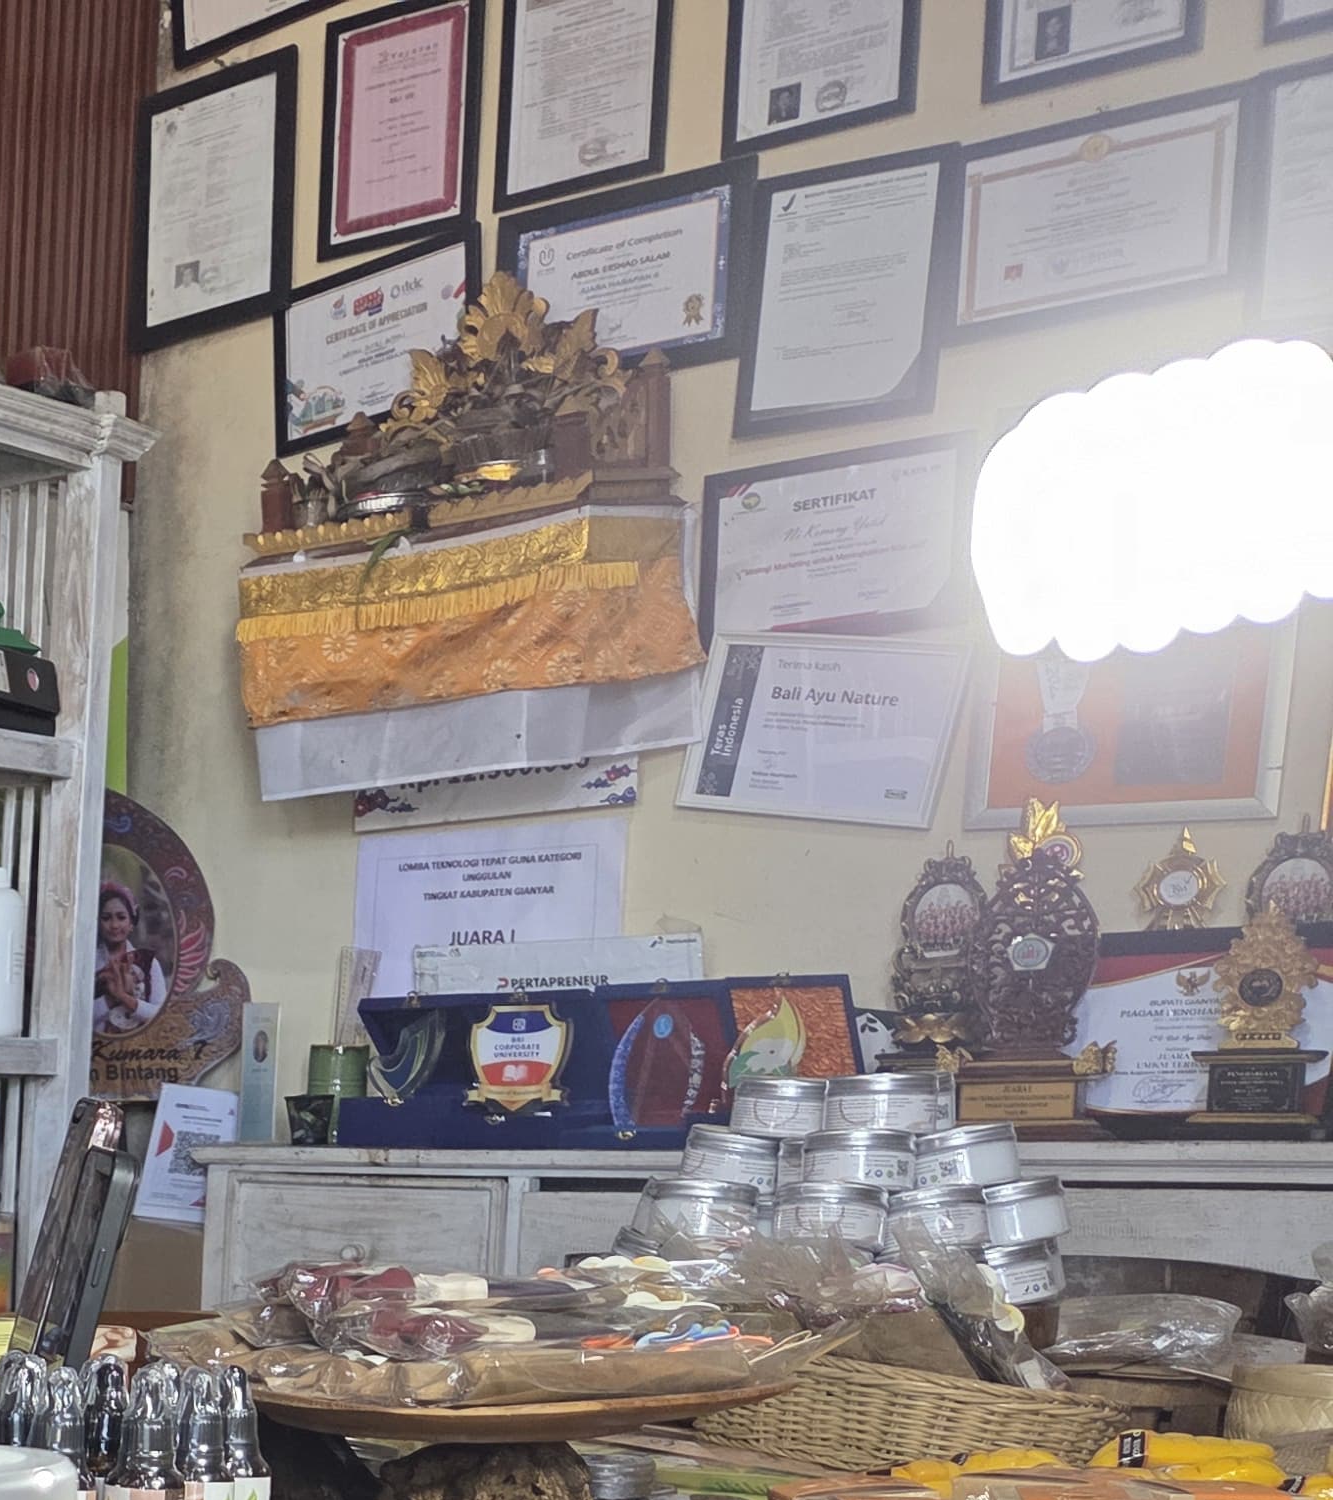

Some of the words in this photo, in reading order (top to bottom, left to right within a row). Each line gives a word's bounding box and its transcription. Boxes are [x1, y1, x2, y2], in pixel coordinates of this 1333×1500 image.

[565, 244, 614, 262] Certificate
[615, 239, 627, 250] of
[627, 228, 684, 248] Completion
[639, 250, 671, 265] SALAM
[325, 321, 368, 345] CERTIFICATE
[367, 318, 378, 330] OF
[377, 302, 429, 329] APPRECIATION
[792, 488, 878, 513] SERTIFIKAT
[777, 659, 814, 671] Terima
[814, 660, 842, 672] kasih
[770, 686, 803, 701] Bali
[804, 687, 837, 706] Ayu
[840, 690, 901, 707] Nature
[721, 696, 745, 757] Indonesia
[709, 722, 728, 756] Teras
[398, 862, 431, 873] LOMBA
[432, 859, 480, 871] TEKNOLOGI
[481, 856, 507, 869] TEPAT
[508, 854, 536, 866] GUNA
[537, 851, 583, 863] KATEGORI
[462, 871, 512, 882] UNGGULAN
[423, 890, 459, 901] TINGKAT
[460, 886, 513, 899] KABUPATEN
[514, 884, 555, 896] GIANYAR
[449, 929, 506, 946] JUARA
[510, 975, 609, 989] PERTAPRENEUR
[1119, 1010, 1164, 1018] PIAGAM
[493, 1043, 541, 1051] CORPORATE
[105, 1063, 179, 1084] Bintang
